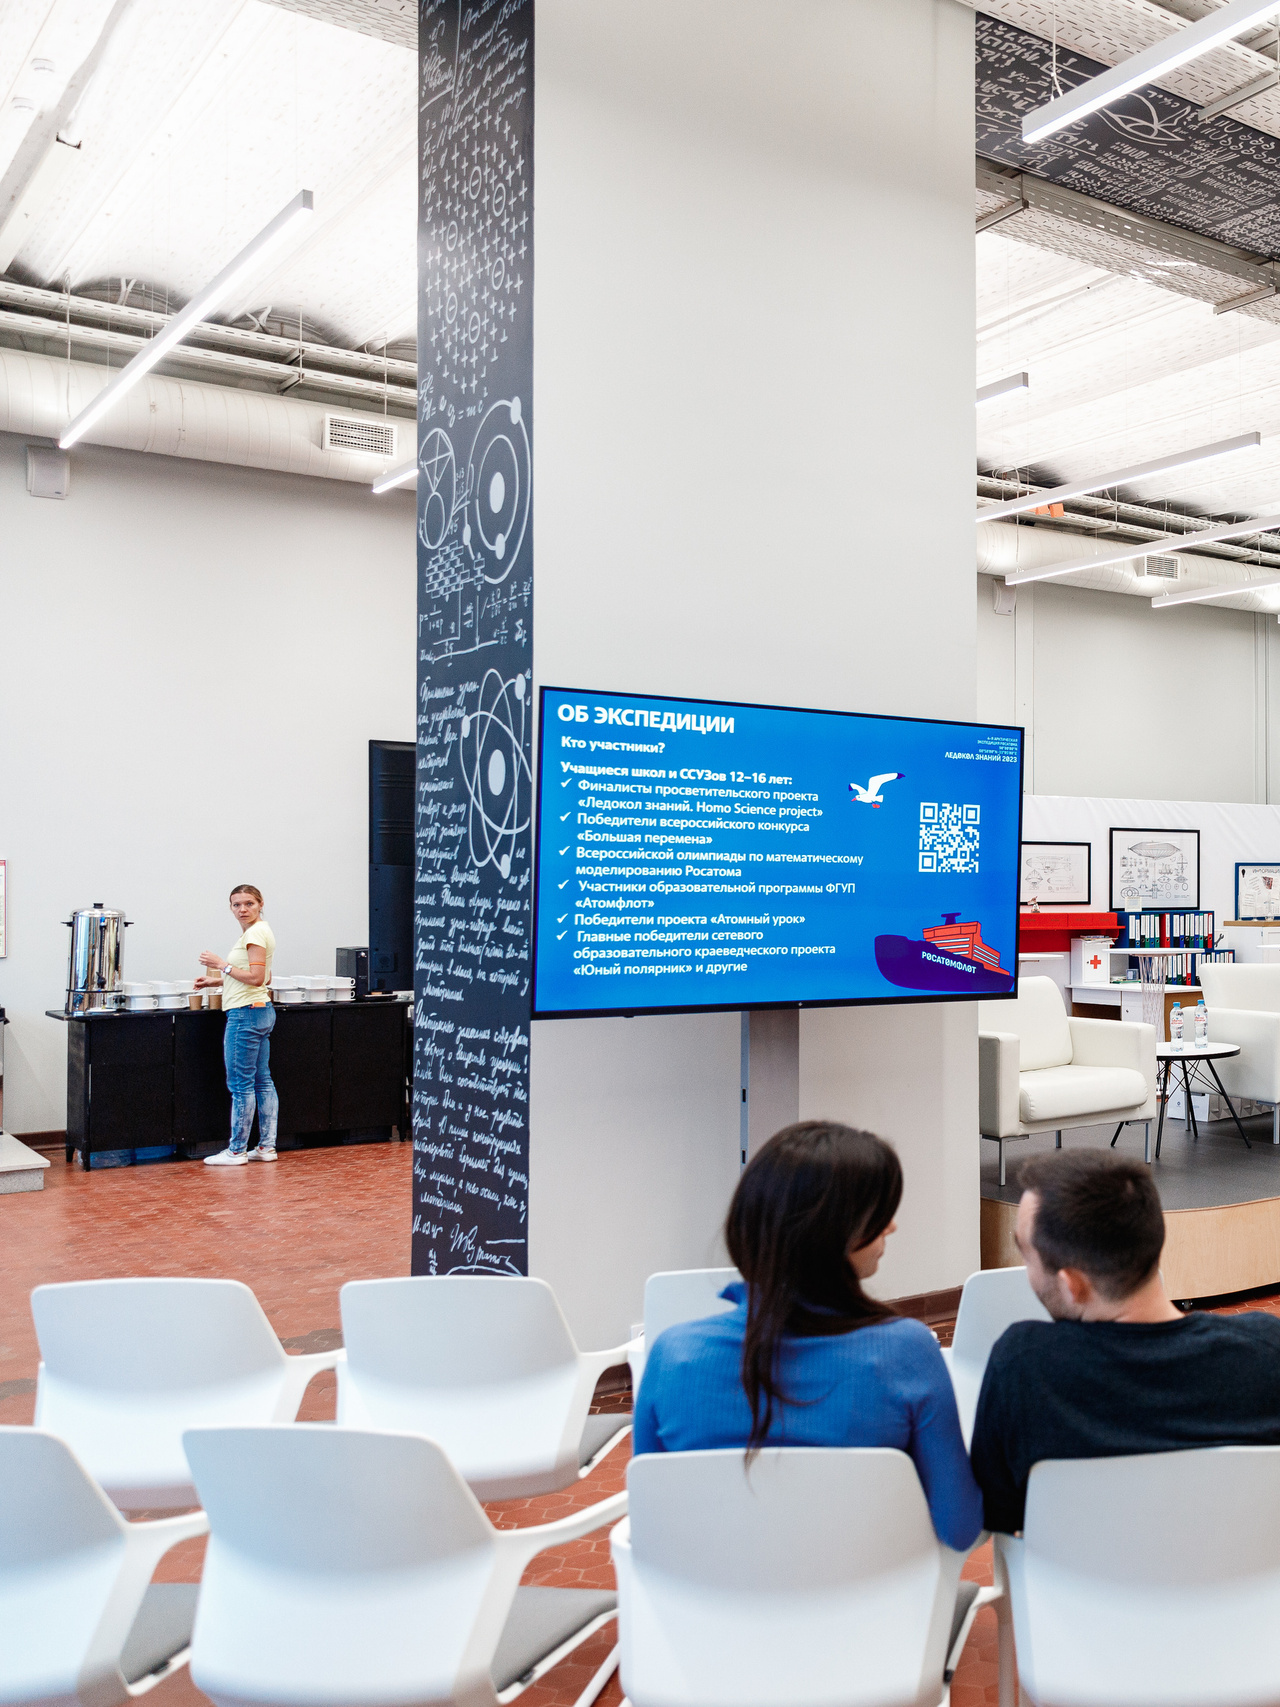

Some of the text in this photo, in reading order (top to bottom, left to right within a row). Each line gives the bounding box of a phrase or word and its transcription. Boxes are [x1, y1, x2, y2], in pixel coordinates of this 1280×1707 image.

[557, 703, 735, 735] ОБ ЭКСПЕДИЦИИ
[561, 735, 666, 753] Кто участники?
[975, 753, 1001, 762] ЗНАНИЙ
[1002, 755, 1018, 763] 2023
[560, 760, 793, 785] Учащиеся школ и ССУЗов 12–16 лет:
[578, 779, 819, 803] Финалисты просветительского проекта
[578, 796, 823, 819] «Ледокол знаний. Homo Science project»
[577, 812, 810, 834] Победители всероссийского конкурса
[576, 829, 713, 846] «Большая перемена»
[576, 846, 864, 866] Всероссийской олимпиады по математическому
[575, 864, 742, 878] моделированию Росатома
[578, 880, 855, 895] Участники образовательной программы ФГУП
[575, 896, 655, 911] «Атомфлот»
[574, 912, 805, 927] Победители проекта «Атомный урок»
[577, 929, 764, 943] Главные победители сетевого
[573, 945, 836, 961] образовательного краеведческого проекта
[573, 963, 748, 976] «Юный полярник» и другие
